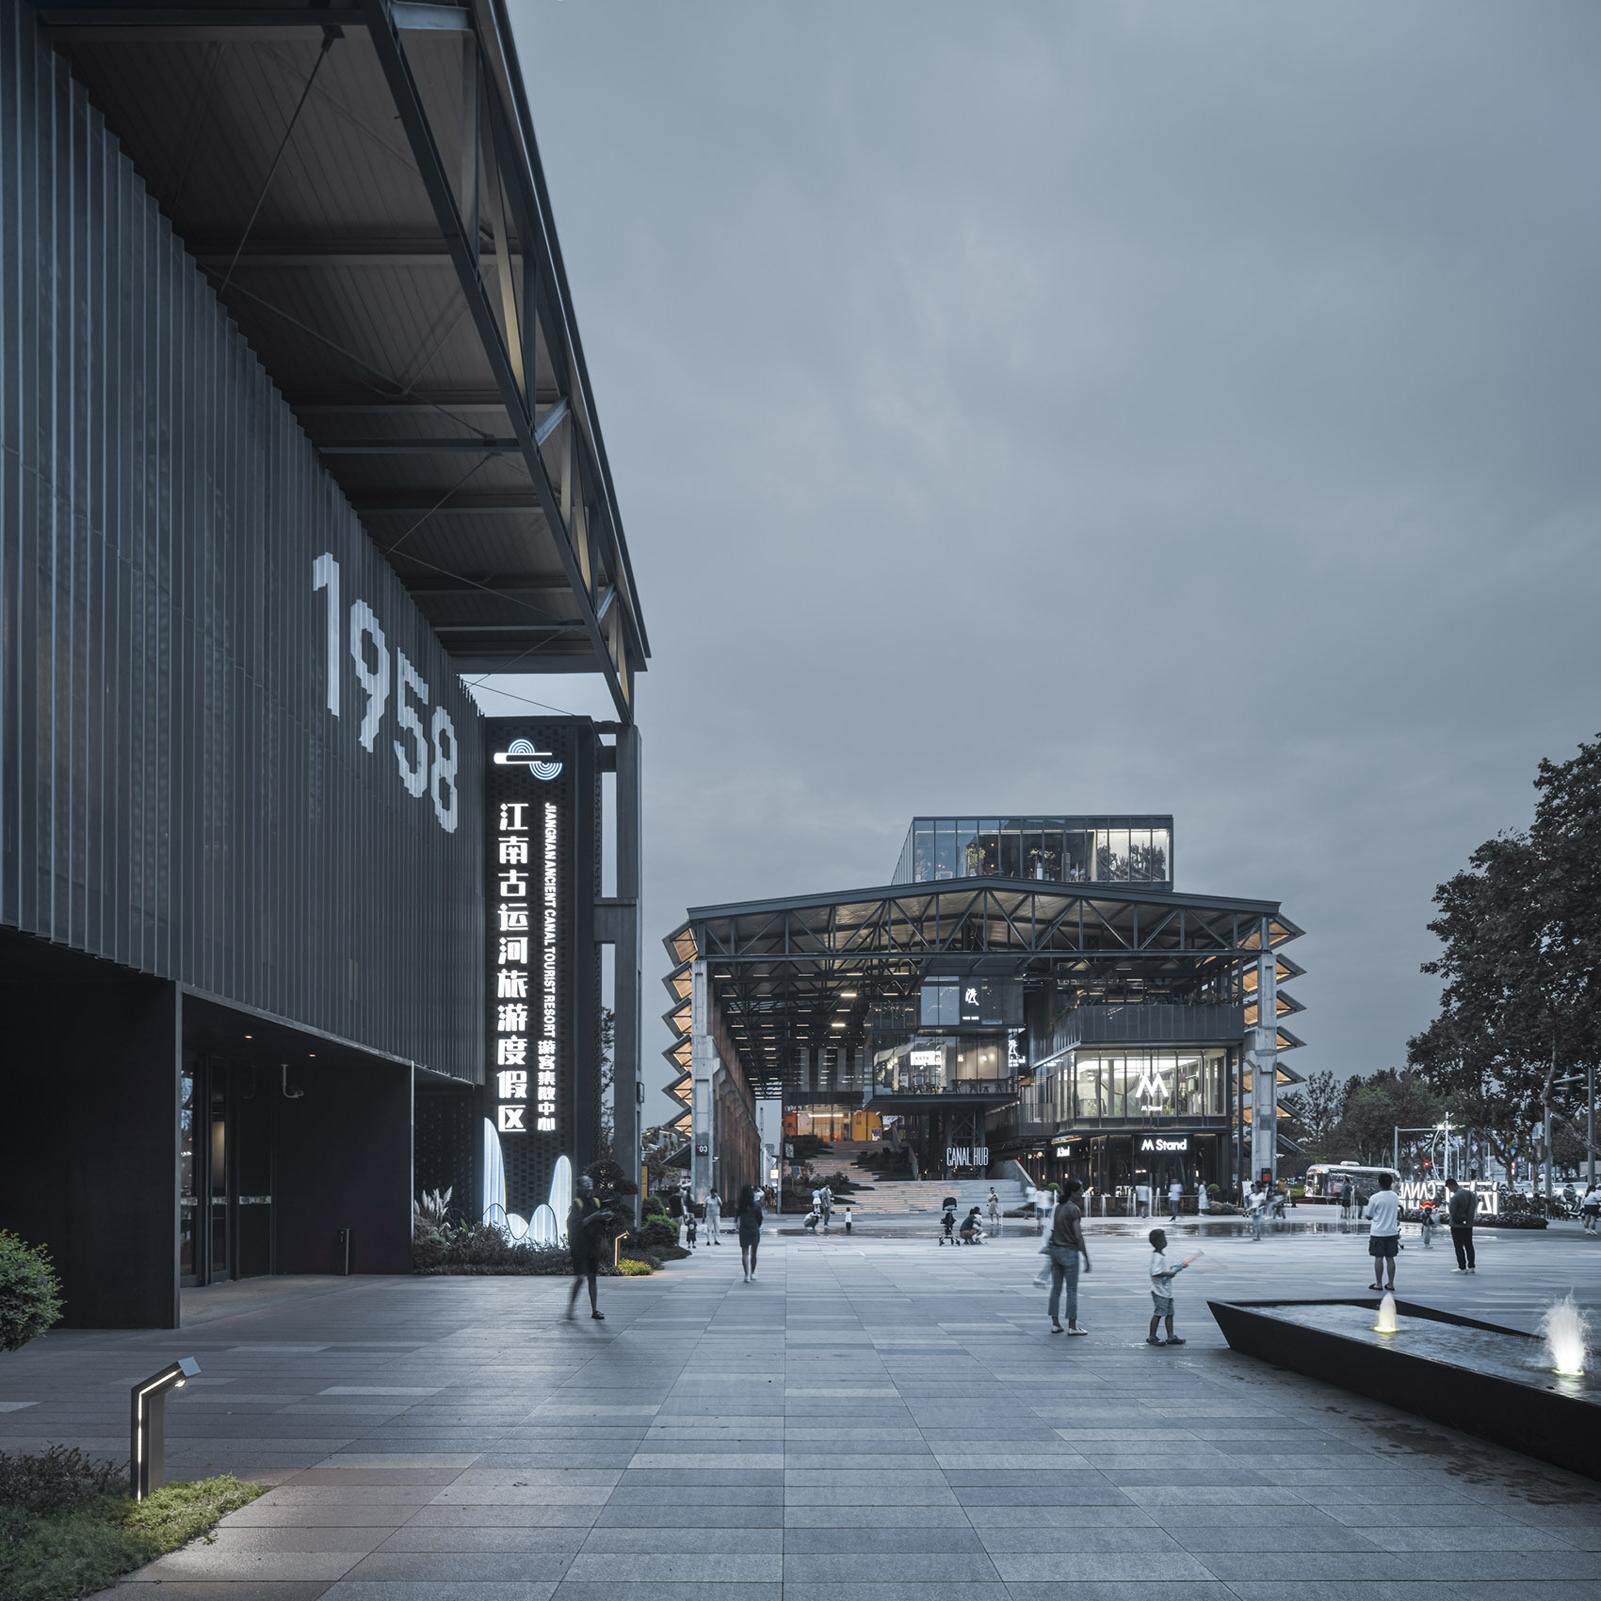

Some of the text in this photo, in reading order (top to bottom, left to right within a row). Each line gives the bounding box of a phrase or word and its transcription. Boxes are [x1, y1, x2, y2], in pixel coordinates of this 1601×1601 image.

[313, 552, 458, 833] 1958
[497, 803, 529, 1132] 江南古运河旅游度假区
[543, 802, 557, 1038] JIANGNAN ANCIENT CANAL TOURIST RESORT
[1135, 1072, 1169, 1098] M
[1141, 1139, 1187, 1151] M Stand
[946, 1147, 989, 1166] CANAL HUB
